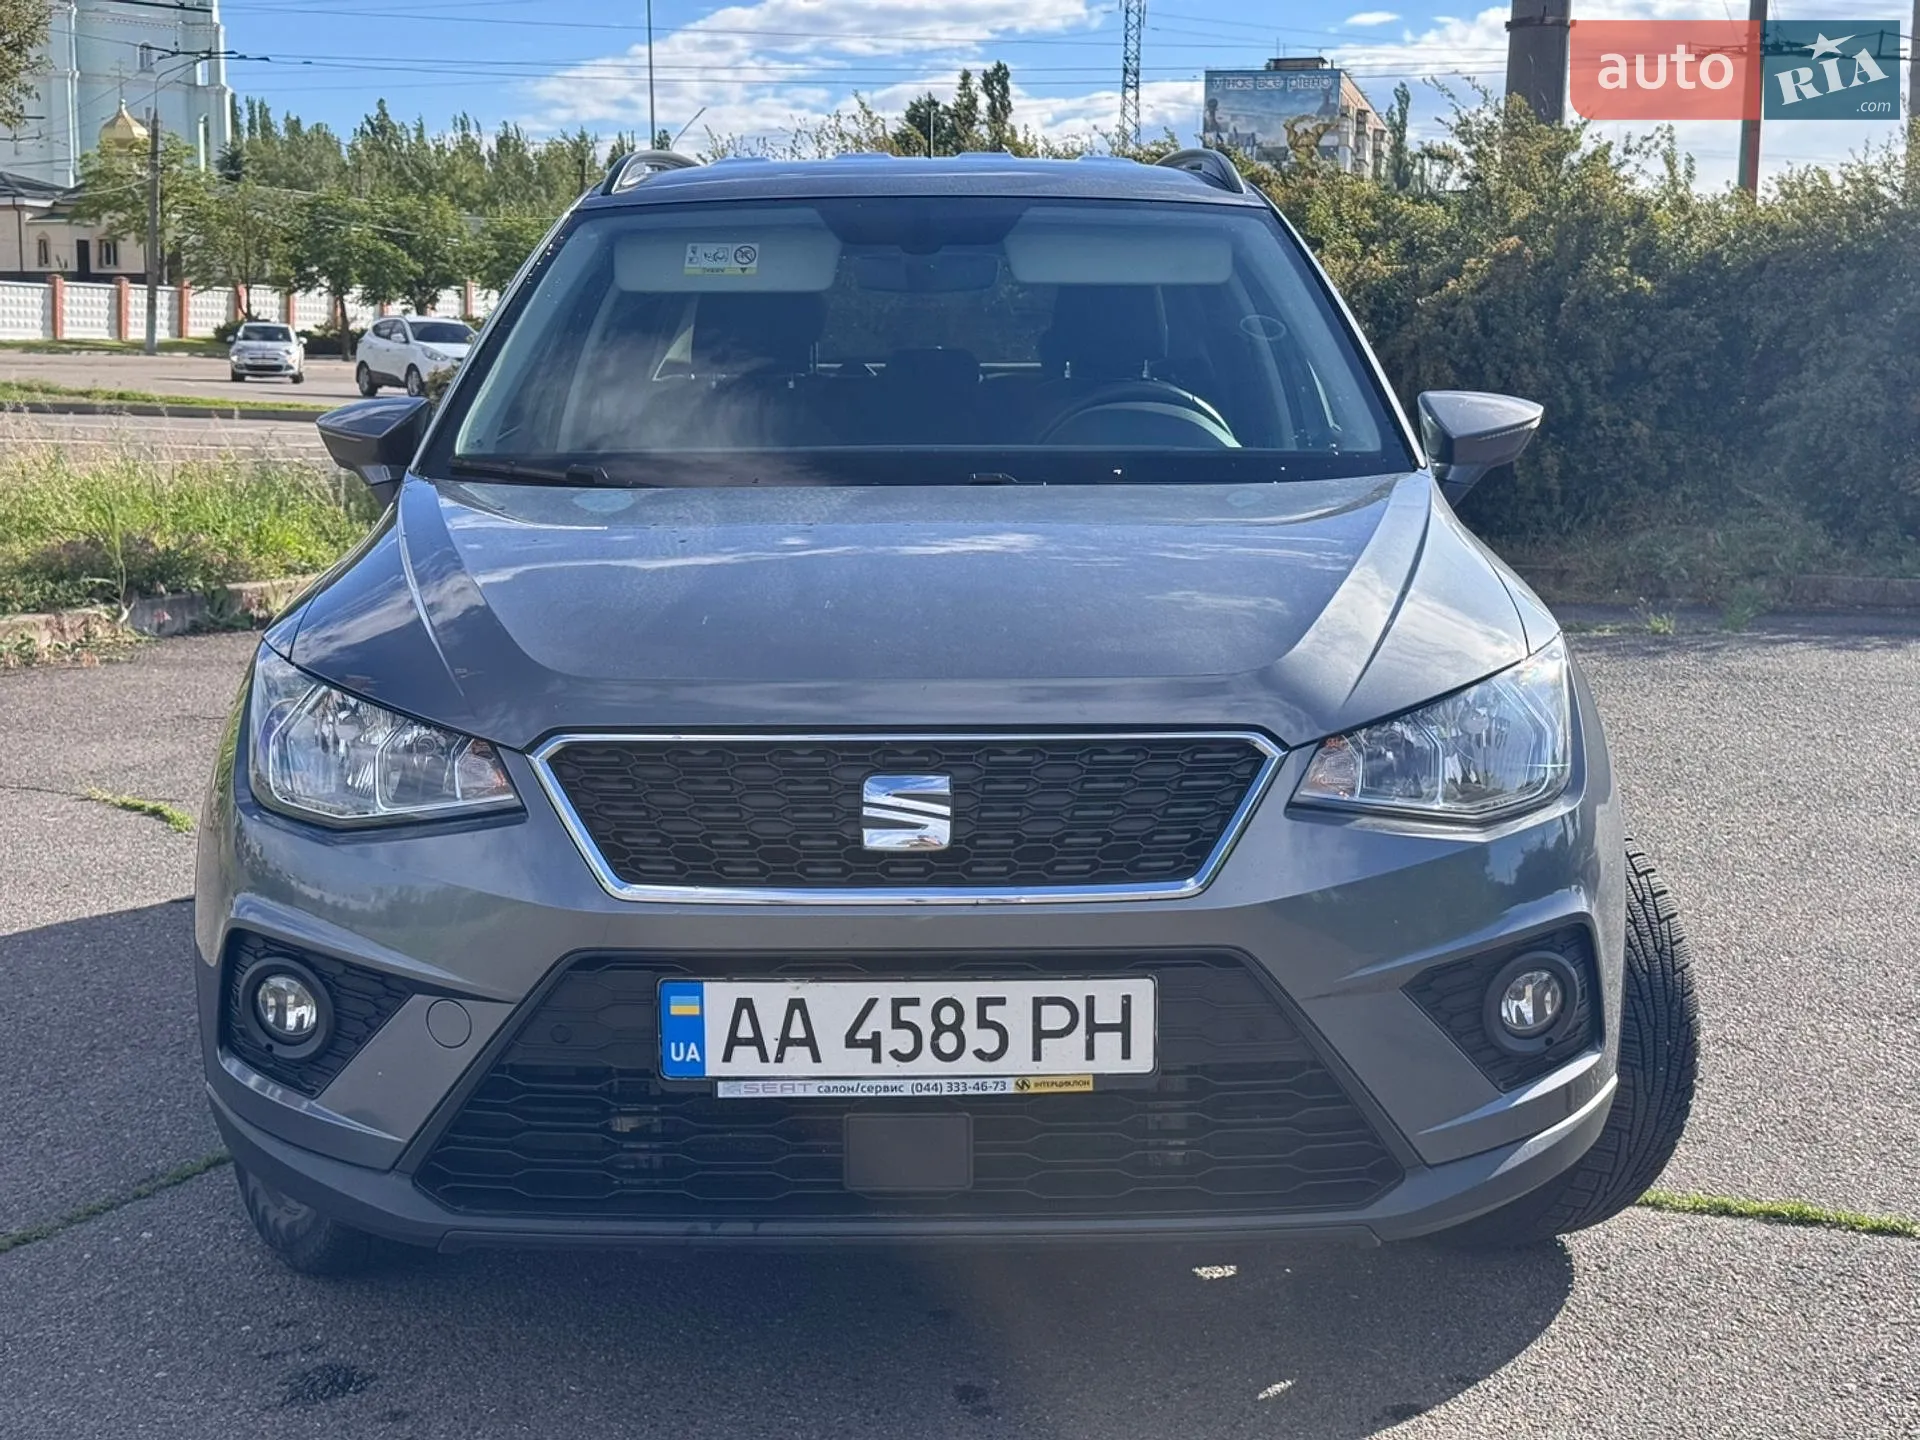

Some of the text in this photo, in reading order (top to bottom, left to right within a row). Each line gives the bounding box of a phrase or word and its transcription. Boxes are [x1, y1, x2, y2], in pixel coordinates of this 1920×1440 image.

[721, 994, 1132, 1064] AA 4585 PH
[671, 1043, 700, 1062] UA
[744, 1083, 812, 1094] SEAT
[817, 1082, 904, 1096] салон/сервис
[911, 1081, 943, 1095] (044)
[947, 1081, 1007, 1093] 333-46-73
